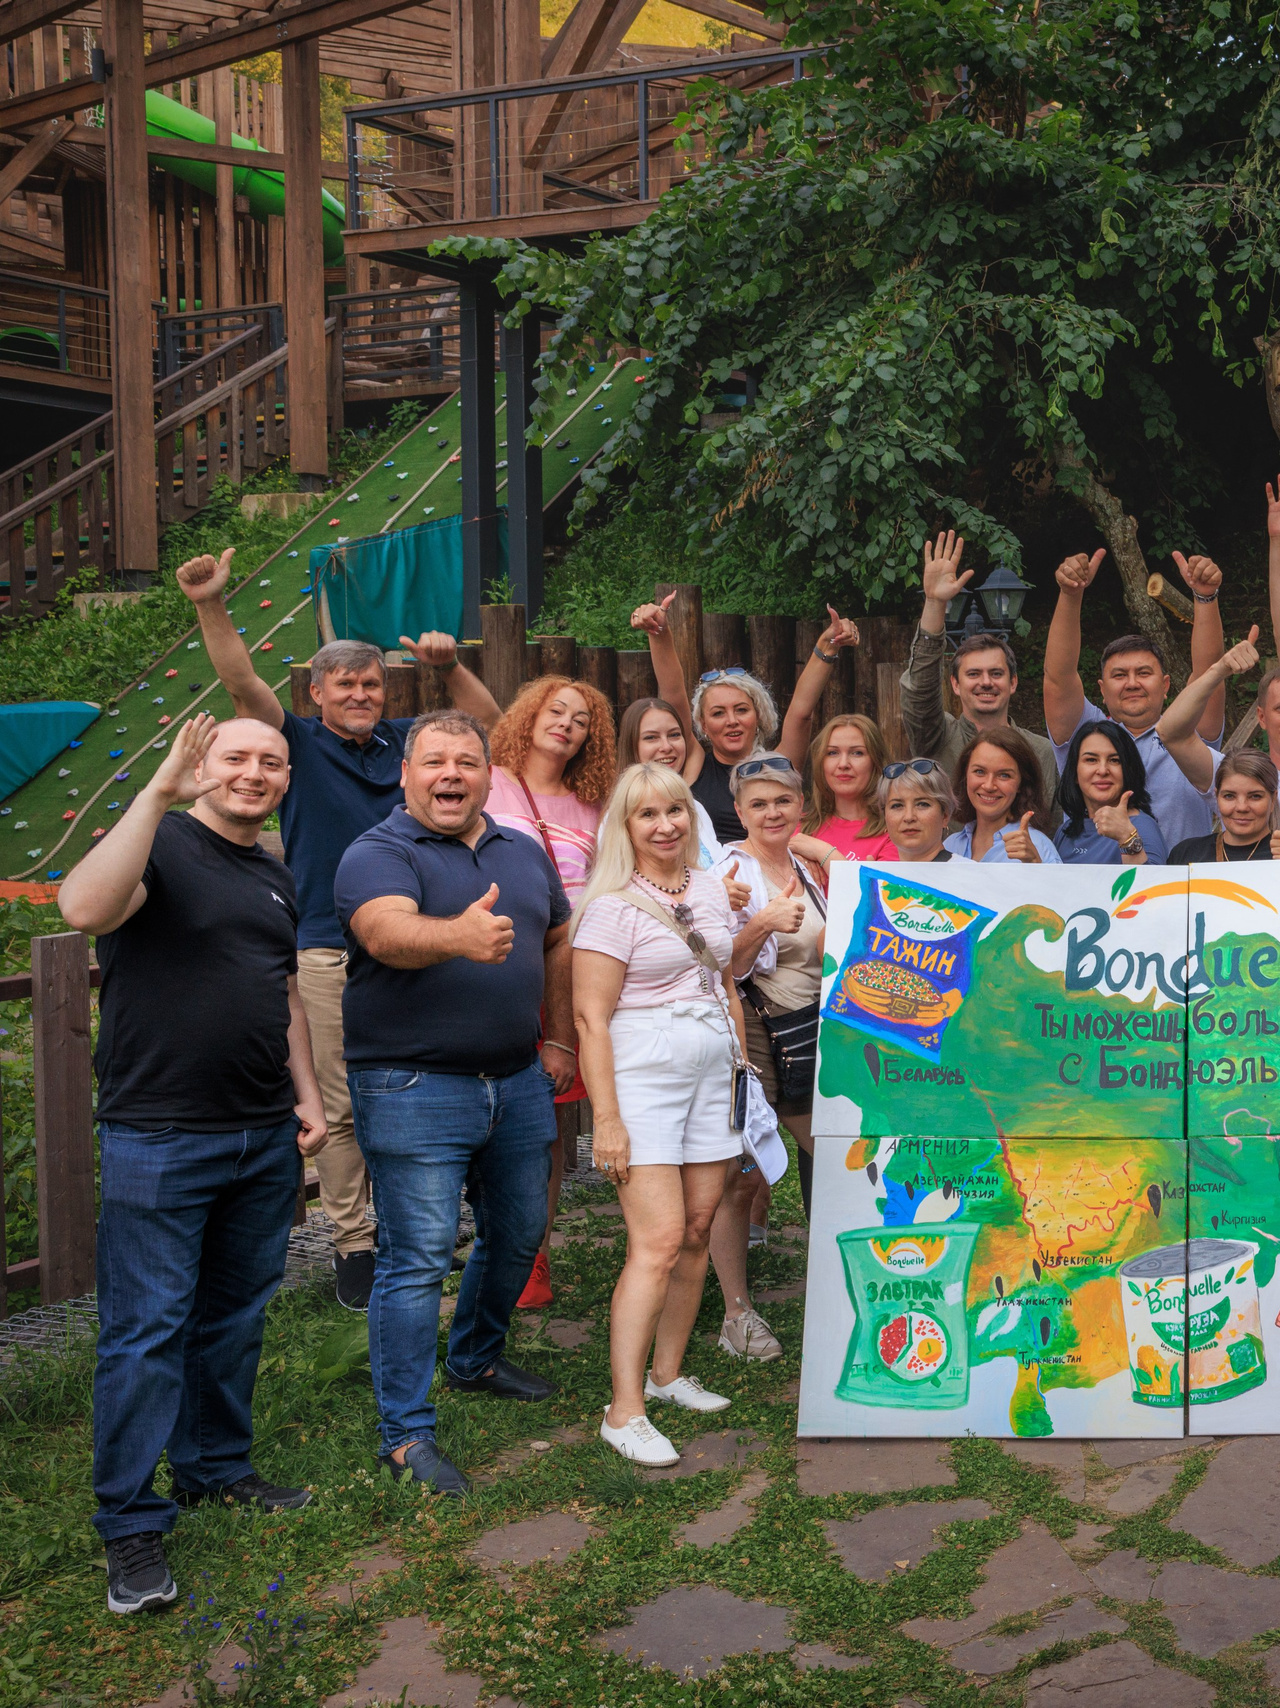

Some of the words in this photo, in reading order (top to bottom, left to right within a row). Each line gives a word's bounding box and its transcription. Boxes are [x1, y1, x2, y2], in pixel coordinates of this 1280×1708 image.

[890, 912, 955, 934] Bonduelle
[868, 926, 957, 975] ТАЖИН
[1034, 1003, 1068, 1039] Ты
[1073, 1010, 1185, 1043] можешь
[1099, 1045, 1278, 1090] Бондюэль
[1221, 1210, 1267, 1229] Киргизия
[886, 1256, 925, 1268] Bonduelle
[867, 1279, 945, 1303] ЗАВТРАК
